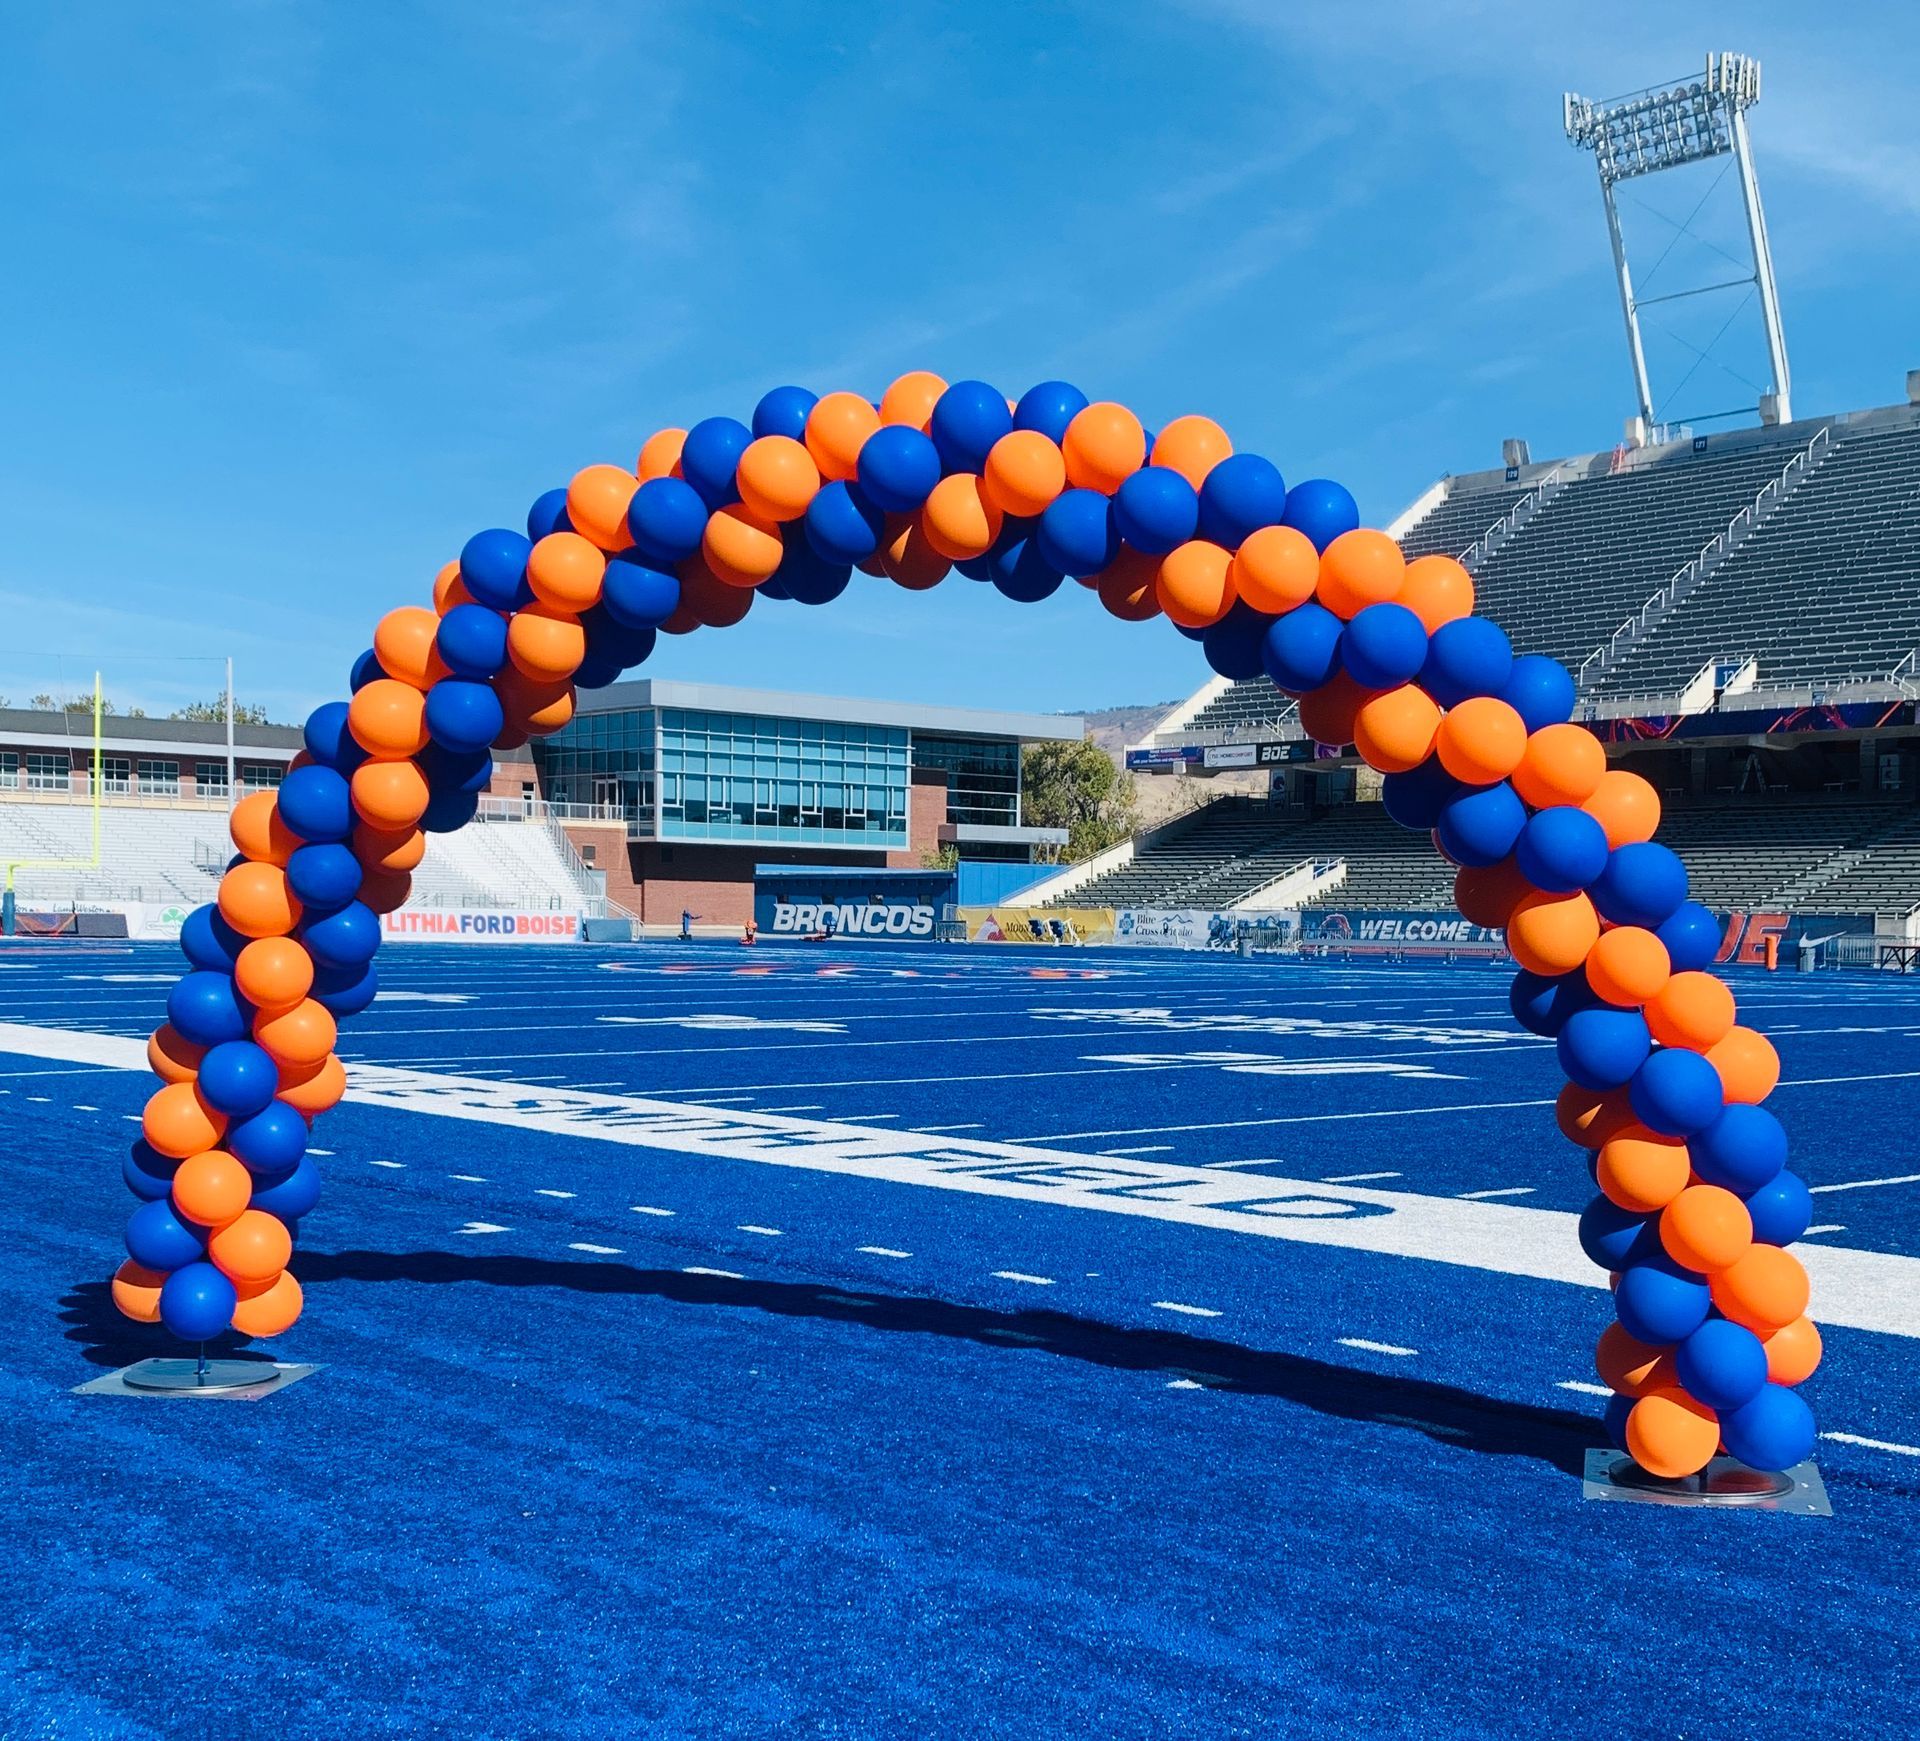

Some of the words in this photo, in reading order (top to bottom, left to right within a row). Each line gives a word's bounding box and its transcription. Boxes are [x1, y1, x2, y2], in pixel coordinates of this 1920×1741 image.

[773, 904, 935, 935] BRONCOS
[1137, 914, 1156, 924] Blue
[1135, 925, 1159, 936] Cross
[1360, 920, 1473, 941] WELCOME
[462, 1098, 874, 1149] SMITH
[838, 1147, 1397, 1219] FIELD
